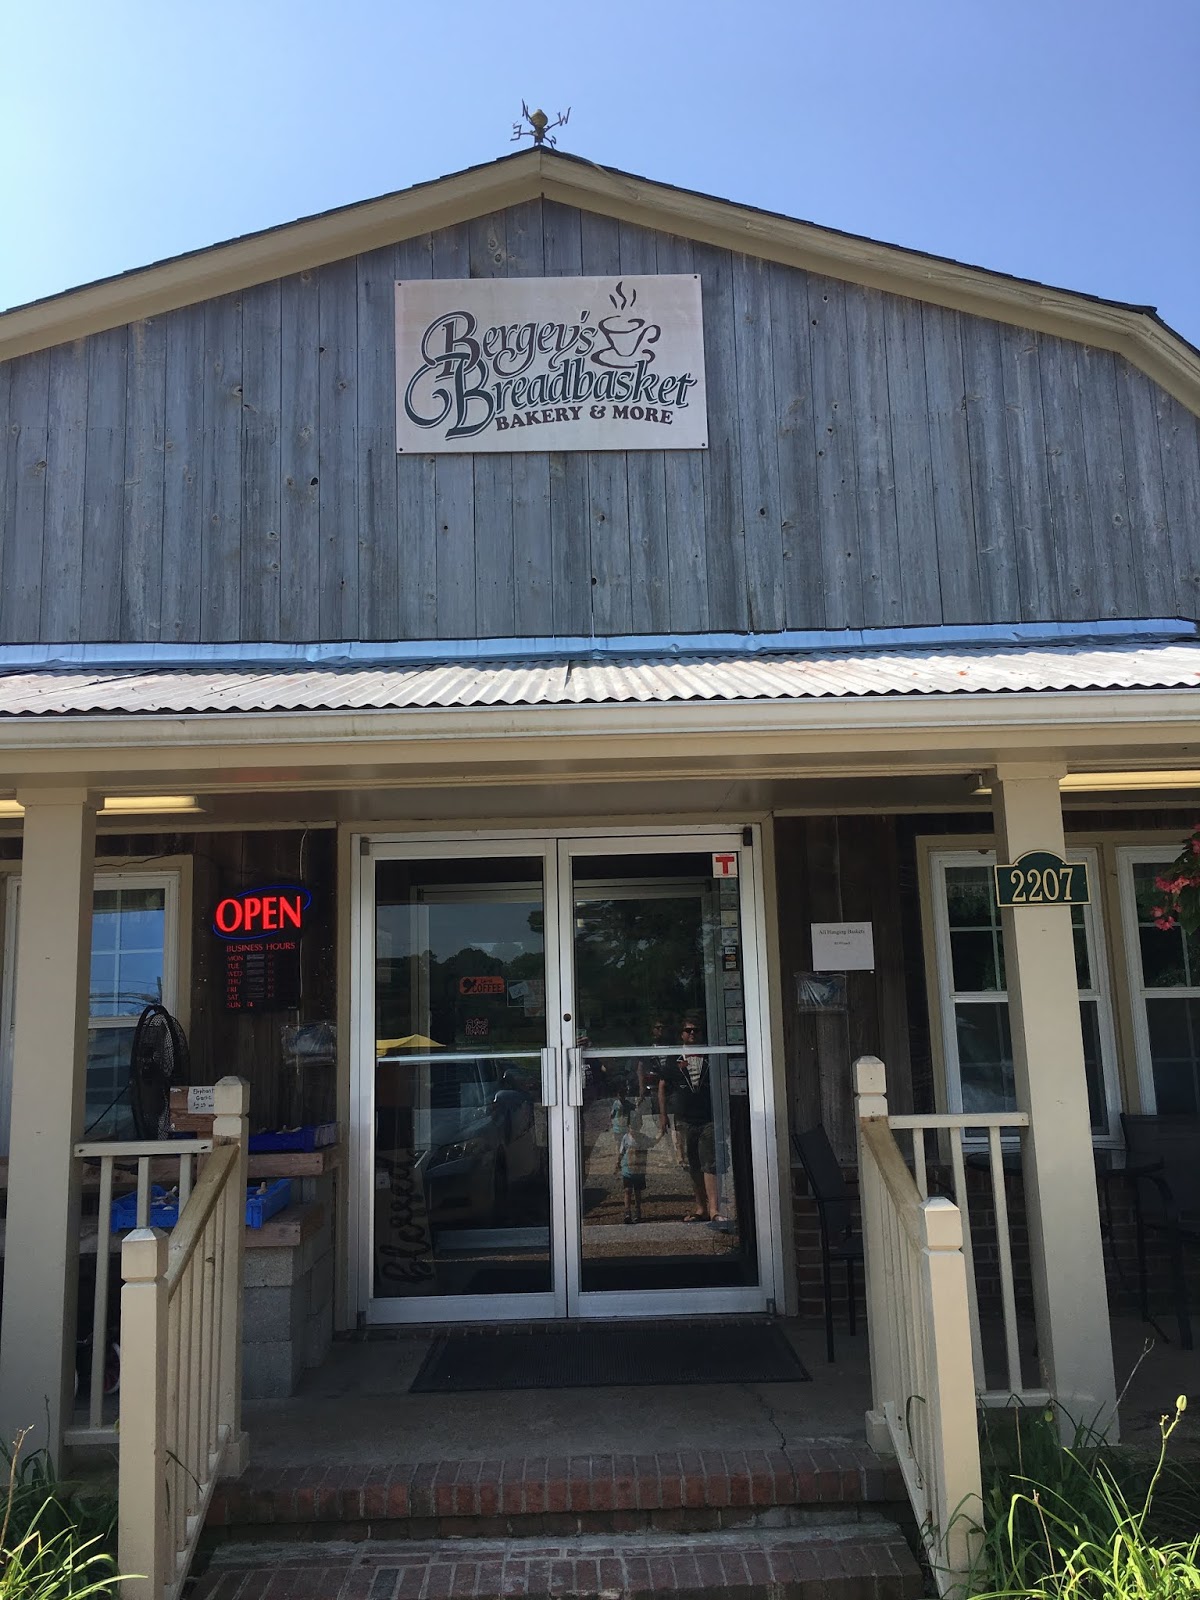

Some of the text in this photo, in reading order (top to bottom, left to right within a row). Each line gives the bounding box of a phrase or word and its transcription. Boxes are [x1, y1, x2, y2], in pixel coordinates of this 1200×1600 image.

[421, 310, 599, 378] Bergey's
[404, 352, 698, 441] Breadbasket
[495, 405, 673, 431] BAKERY & MORE
[715, 857, 735, 874] T
[1010, 868, 1073, 902] 2207
[215, 896, 301, 932] OPEN
[226, 942, 295, 952] BUSINESS HOURS
